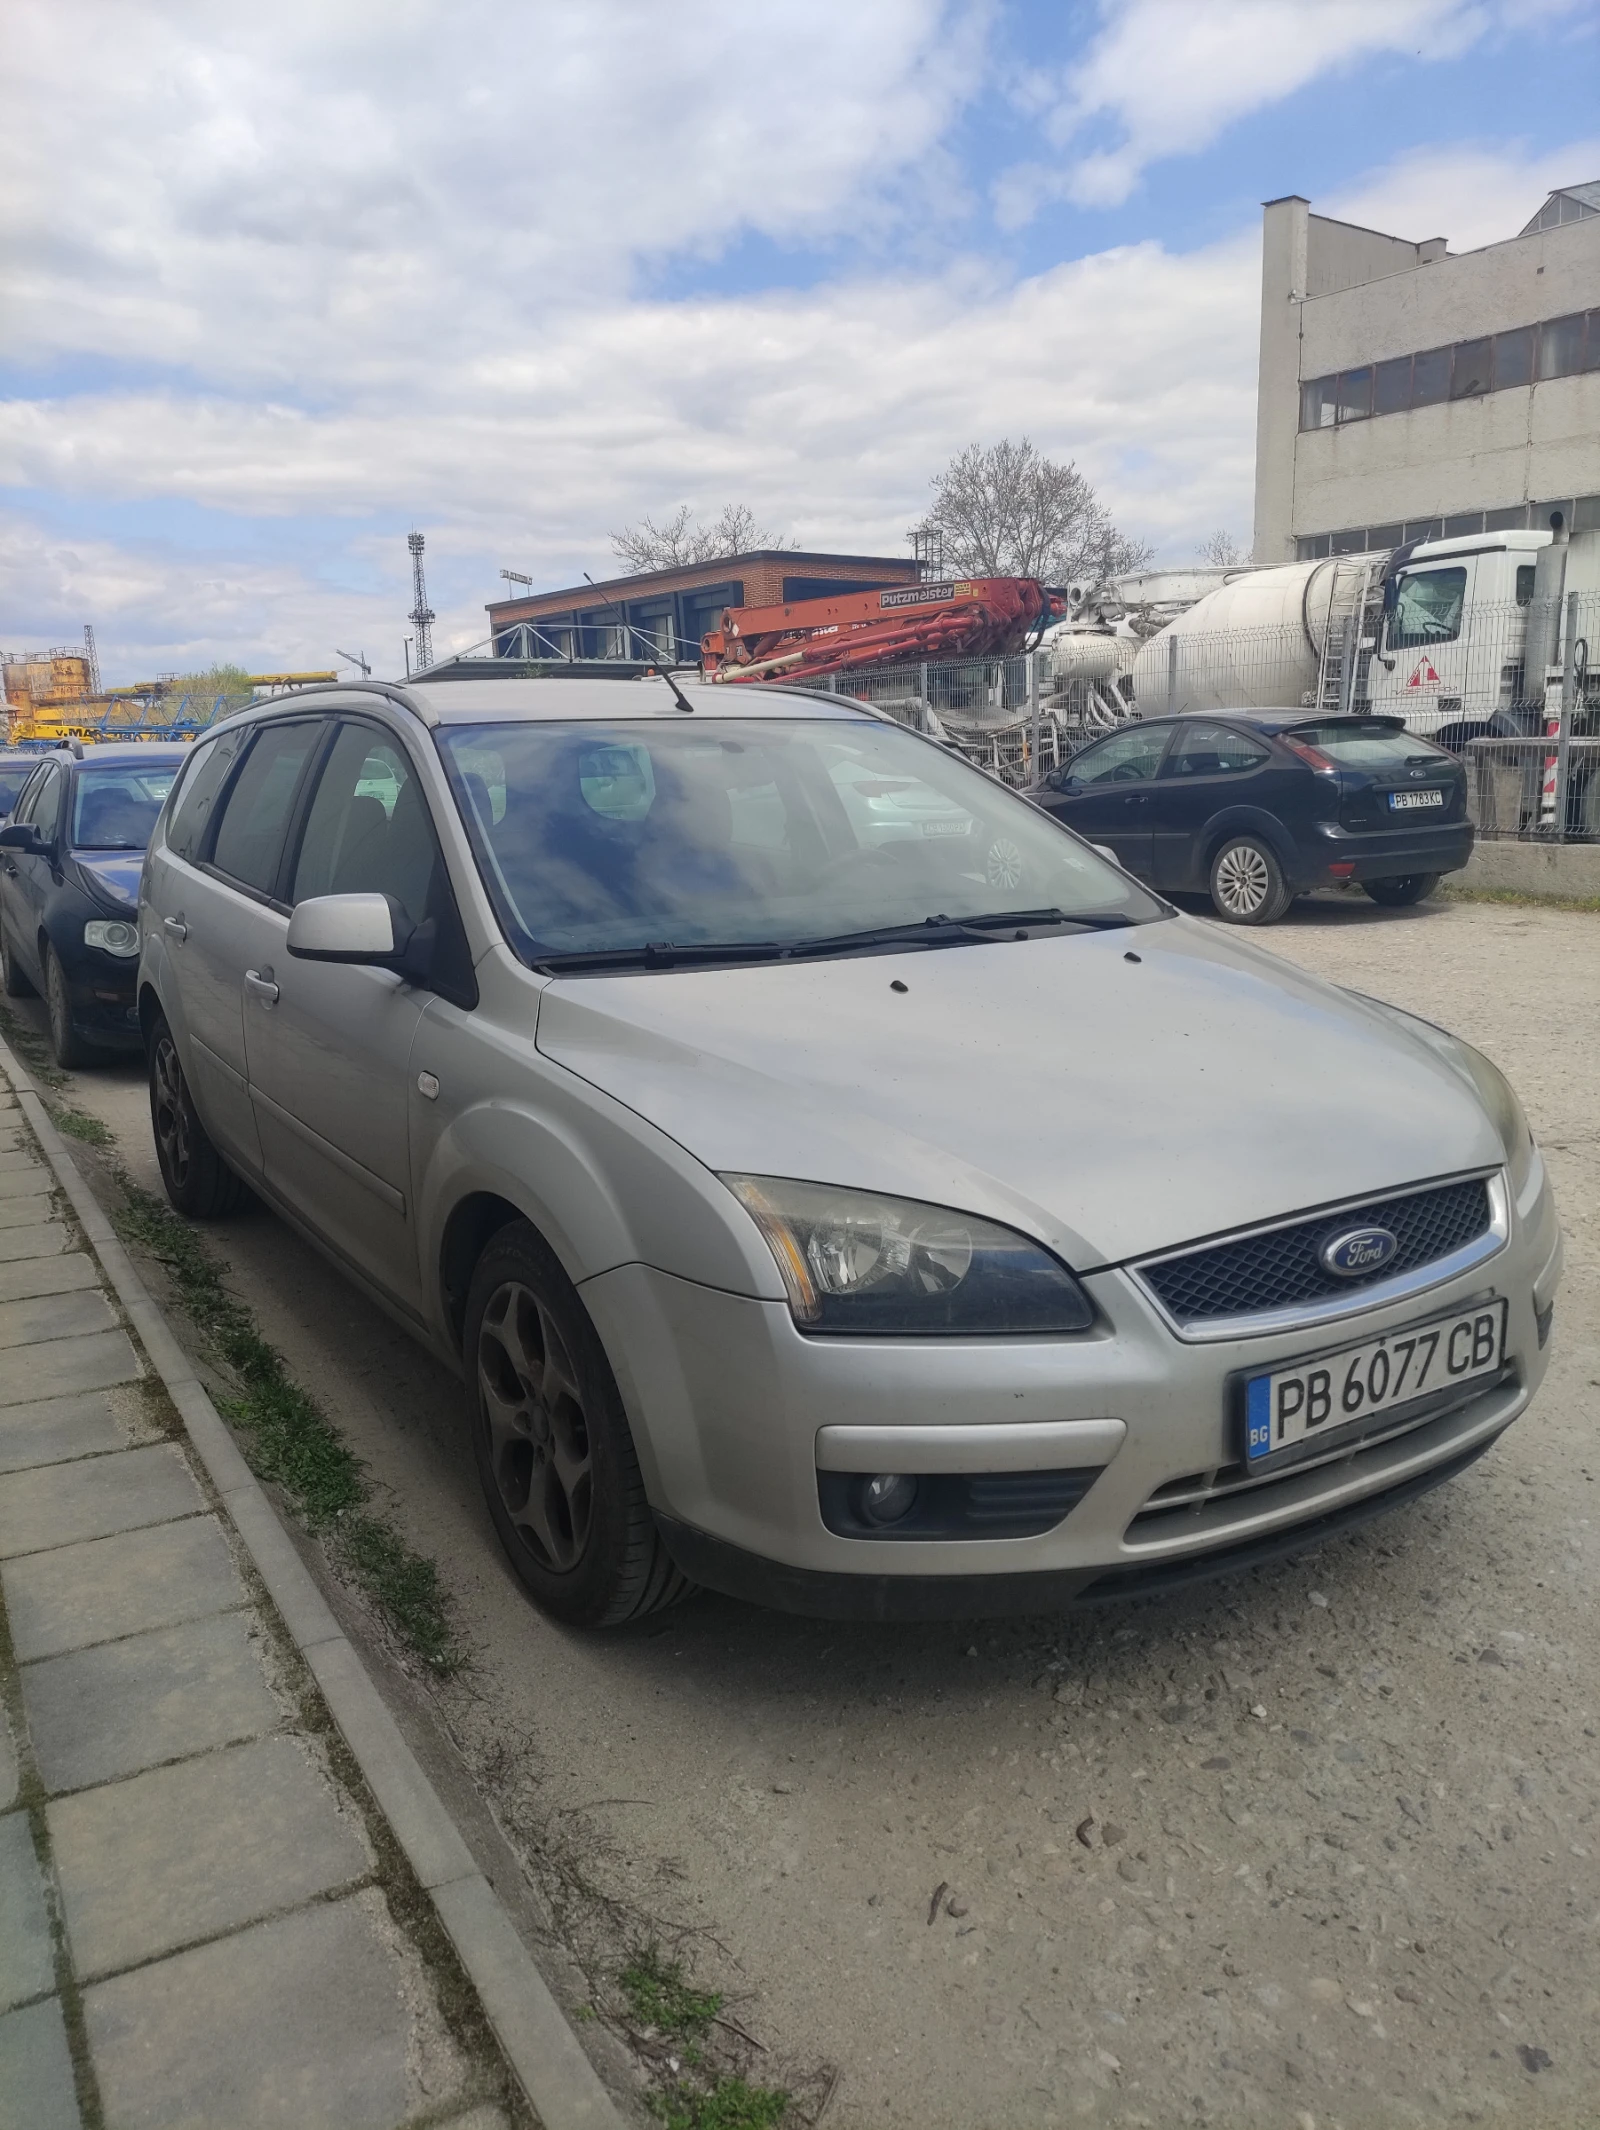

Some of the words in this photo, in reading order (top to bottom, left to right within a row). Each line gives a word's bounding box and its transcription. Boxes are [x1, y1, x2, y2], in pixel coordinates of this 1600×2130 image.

[882, 586, 954, 606] Putzmeister
[1395, 794, 1408, 807] PB
[1430, 791, 1441, 804] KC
[1347, 1238, 1384, 1266] Ford
[1277, 1369, 1332, 1440] PB
[1341, 1330, 1441, 1413] 6077
[1447, 1313, 1495, 1376] CB
[1250, 1425, 1269, 1447] BG
